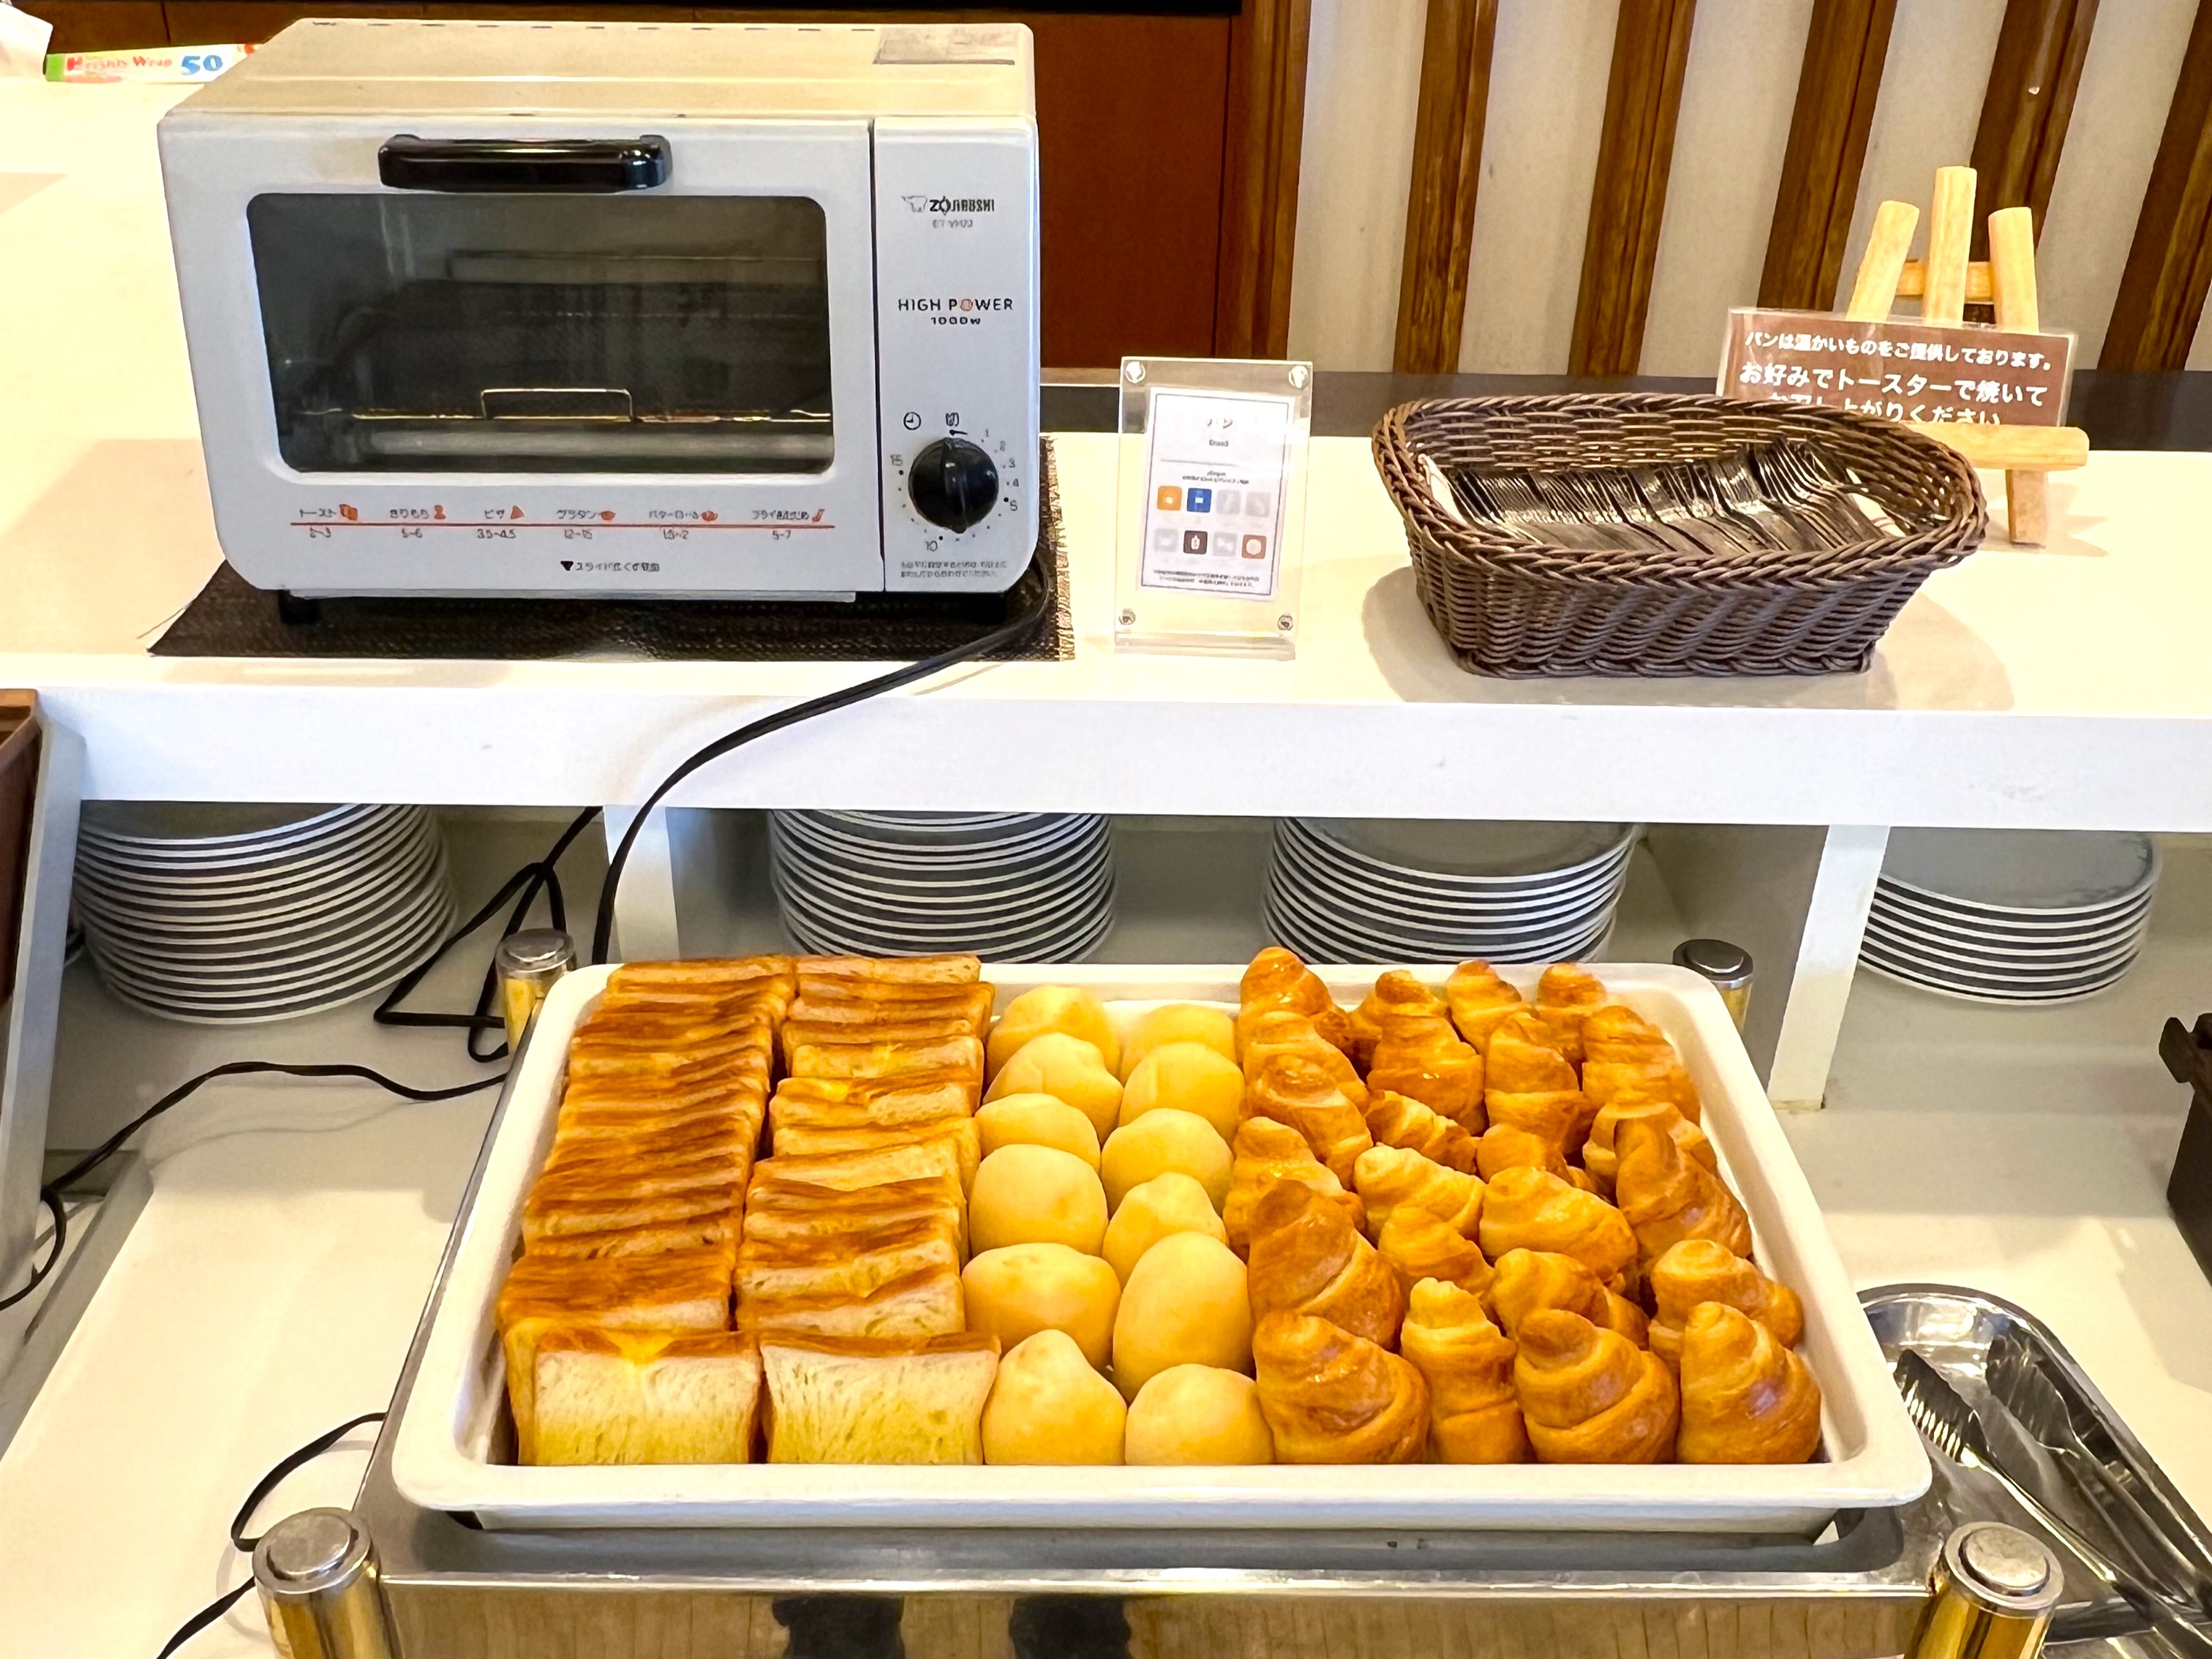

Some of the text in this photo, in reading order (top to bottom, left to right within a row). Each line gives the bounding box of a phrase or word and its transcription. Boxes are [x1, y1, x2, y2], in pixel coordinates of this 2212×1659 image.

[181, 55, 224, 75] 50
[898, 298, 1013, 312] HIGH POWER
[1739, 361, 2048, 407] お好みでトースターで焼いて
[1012, 478, 1020, 488] 4
[1009, 500, 1018, 511] 5
[925, 540, 938, 552] 10
